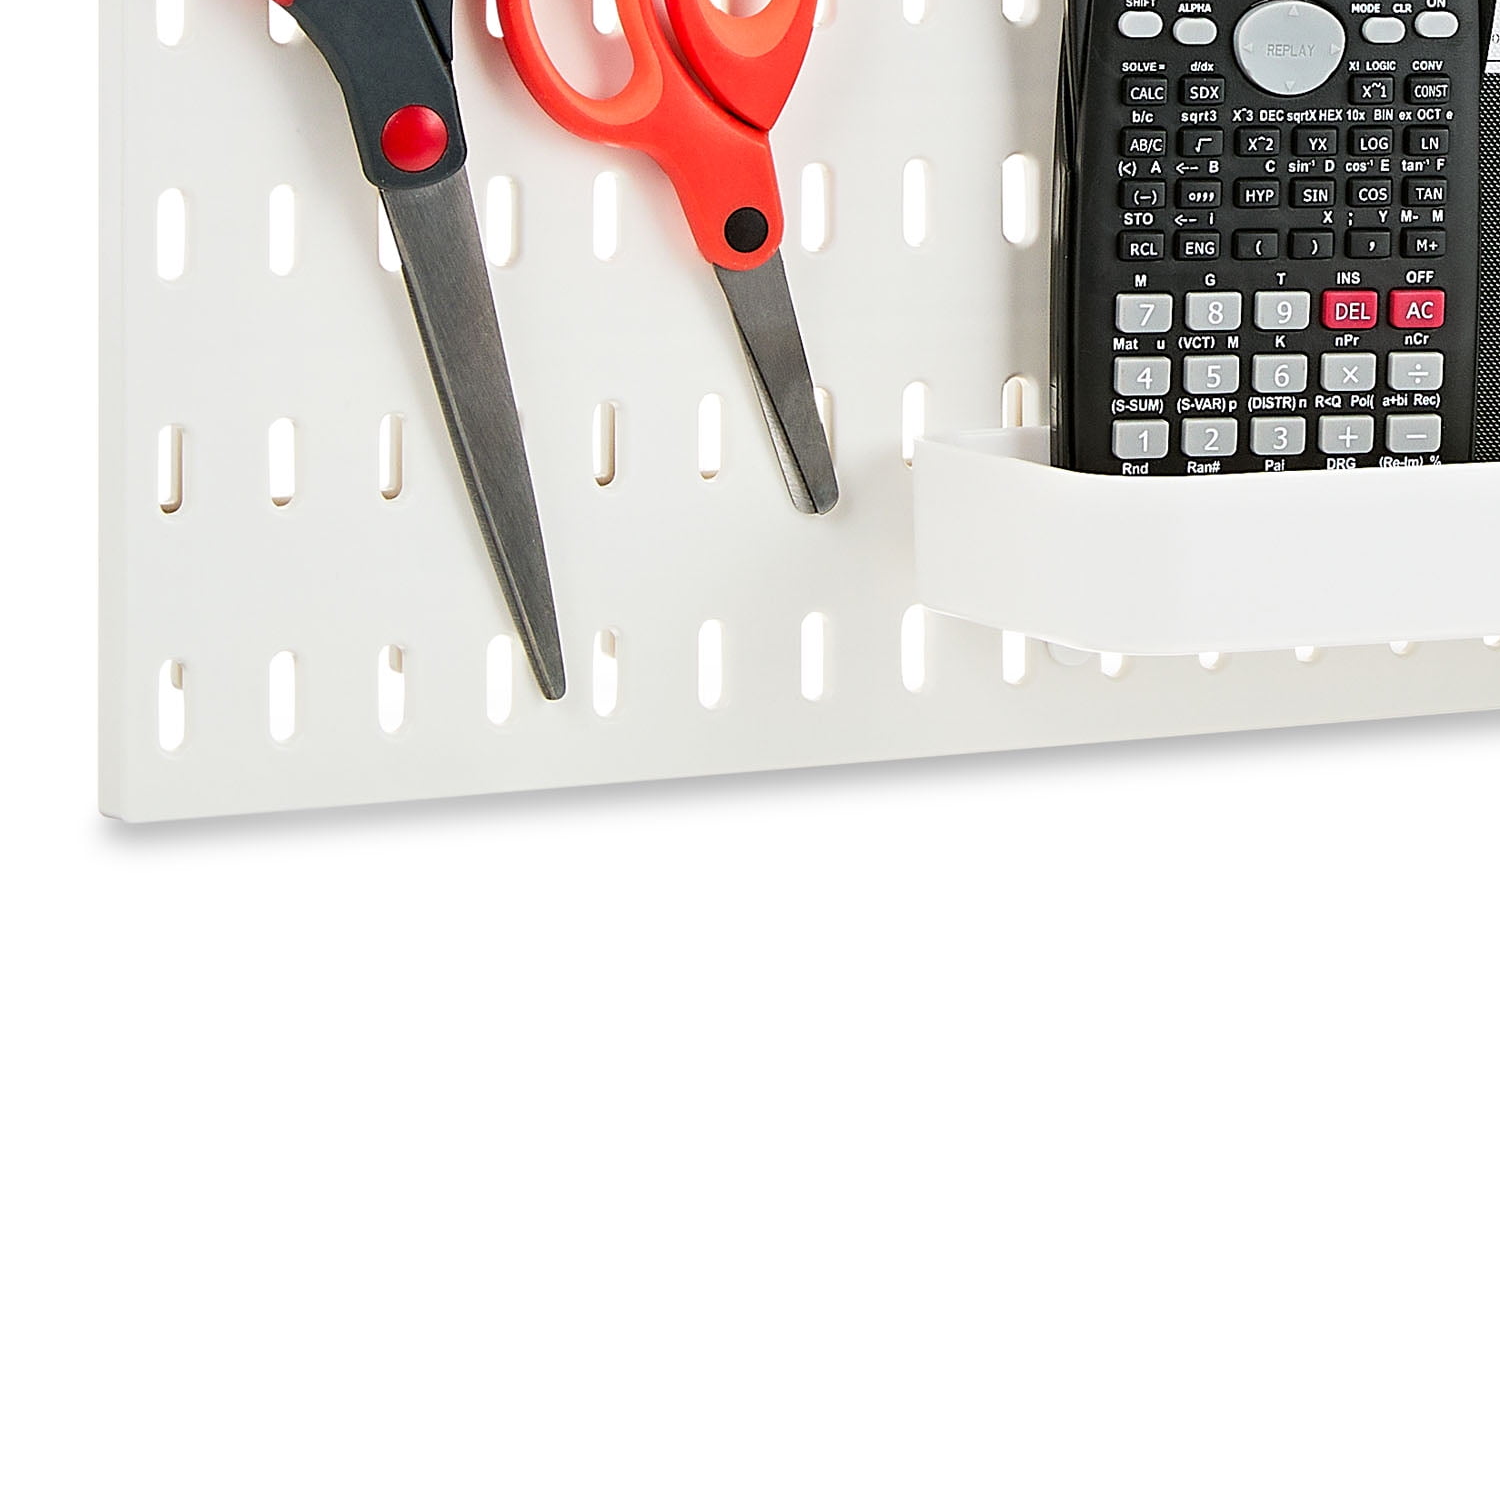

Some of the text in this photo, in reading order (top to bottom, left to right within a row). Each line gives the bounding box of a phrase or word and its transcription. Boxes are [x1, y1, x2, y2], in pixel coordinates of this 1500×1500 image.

[1177, 3, 1212, 13] ALPHA
[1351, 3, 1413, 14] MODE CLR
[1266, 42, 1316, 58] REPLAY
[1121, 61, 1157, 72] SOLVE
[1190, 61, 1214, 72] d/dx
[1365, 60, 1397, 71] LOGIC
[1412, 60, 1443, 71] CONV
[1130, 86, 1164, 100] CALC
[1189, 86, 1220, 100] SDX
[1414, 84, 1449, 98] CONST
[1132, 110, 1154, 123] b/c
[1181, 109, 1217, 125] sqrt3
[1259, 109, 1285, 122] DEC
[1318, 108, 1343, 122] HEX
[1346, 108, 1394, 121] 10x BIN
[1416, 108, 1442, 121] OCT
[1129, 138, 1163, 154] AB/C
[1308, 137, 1327, 151] YX
[1360, 136, 1389, 151] LOG
[1421, 137, 1439, 150] LN
[1150, 160, 1162, 174] A
[1208, 160, 1219, 174] B
[1265, 159, 1276, 173] C
[1324, 159, 1335, 173] D
[1380, 158, 1390, 172] E
[1436, 158, 1445, 171] F
[1245, 189, 1275, 203] HYP
[1303, 188, 1328, 203] SIN
[1358, 187, 1388, 202] COS
[1415, 187, 1443, 200] TAN
[1123, 212, 1154, 225] STO
[1322, 210, 1333, 224] X
[1378, 210, 1388, 223] Y
[1432, 209, 1444, 222] M
[1130, 242, 1158, 256] RCL
[1185, 241, 1215, 255] ENG
[1416, 238, 1438, 252] M+
[1134, 274, 1147, 288] M
[1205, 273, 1216, 286] G
[1276, 272, 1286, 285] T
[1336, 271, 1361, 285] INS
[1405, 270, 1435, 284] OFF
[1139, 303, 1155, 326] 7
[1208, 301, 1224, 325] 8
[1277, 301, 1292, 324] 9
[1335, 302, 1371, 321] DEL
[1406, 301, 1434, 319] AC
[1113, 337, 1139, 351] Mat
[1178, 335, 1239, 349] (VCT) M
[1275, 335, 1286, 348] K
[1335, 333, 1360, 347] nPr
[1404, 332, 1430, 345] nCr
[1136, 367, 1153, 390] 4
[1206, 365, 1221, 388] 5
[1274, 364, 1290, 387] 6
[1111, 398, 1164, 415] (S-SUM)
[1247, 395, 1297, 413] (DISTR)
[1382, 393, 1441, 409] a+bi Rec)
[1138, 430, 1148, 452] 1
[1204, 428, 1219, 451] 2
[1273, 426, 1288, 450] 3
[1122, 462, 1149, 475] Rnd
[1187, 460, 1221, 474] Ran#
[1325, 456, 1358, 470] DRG
